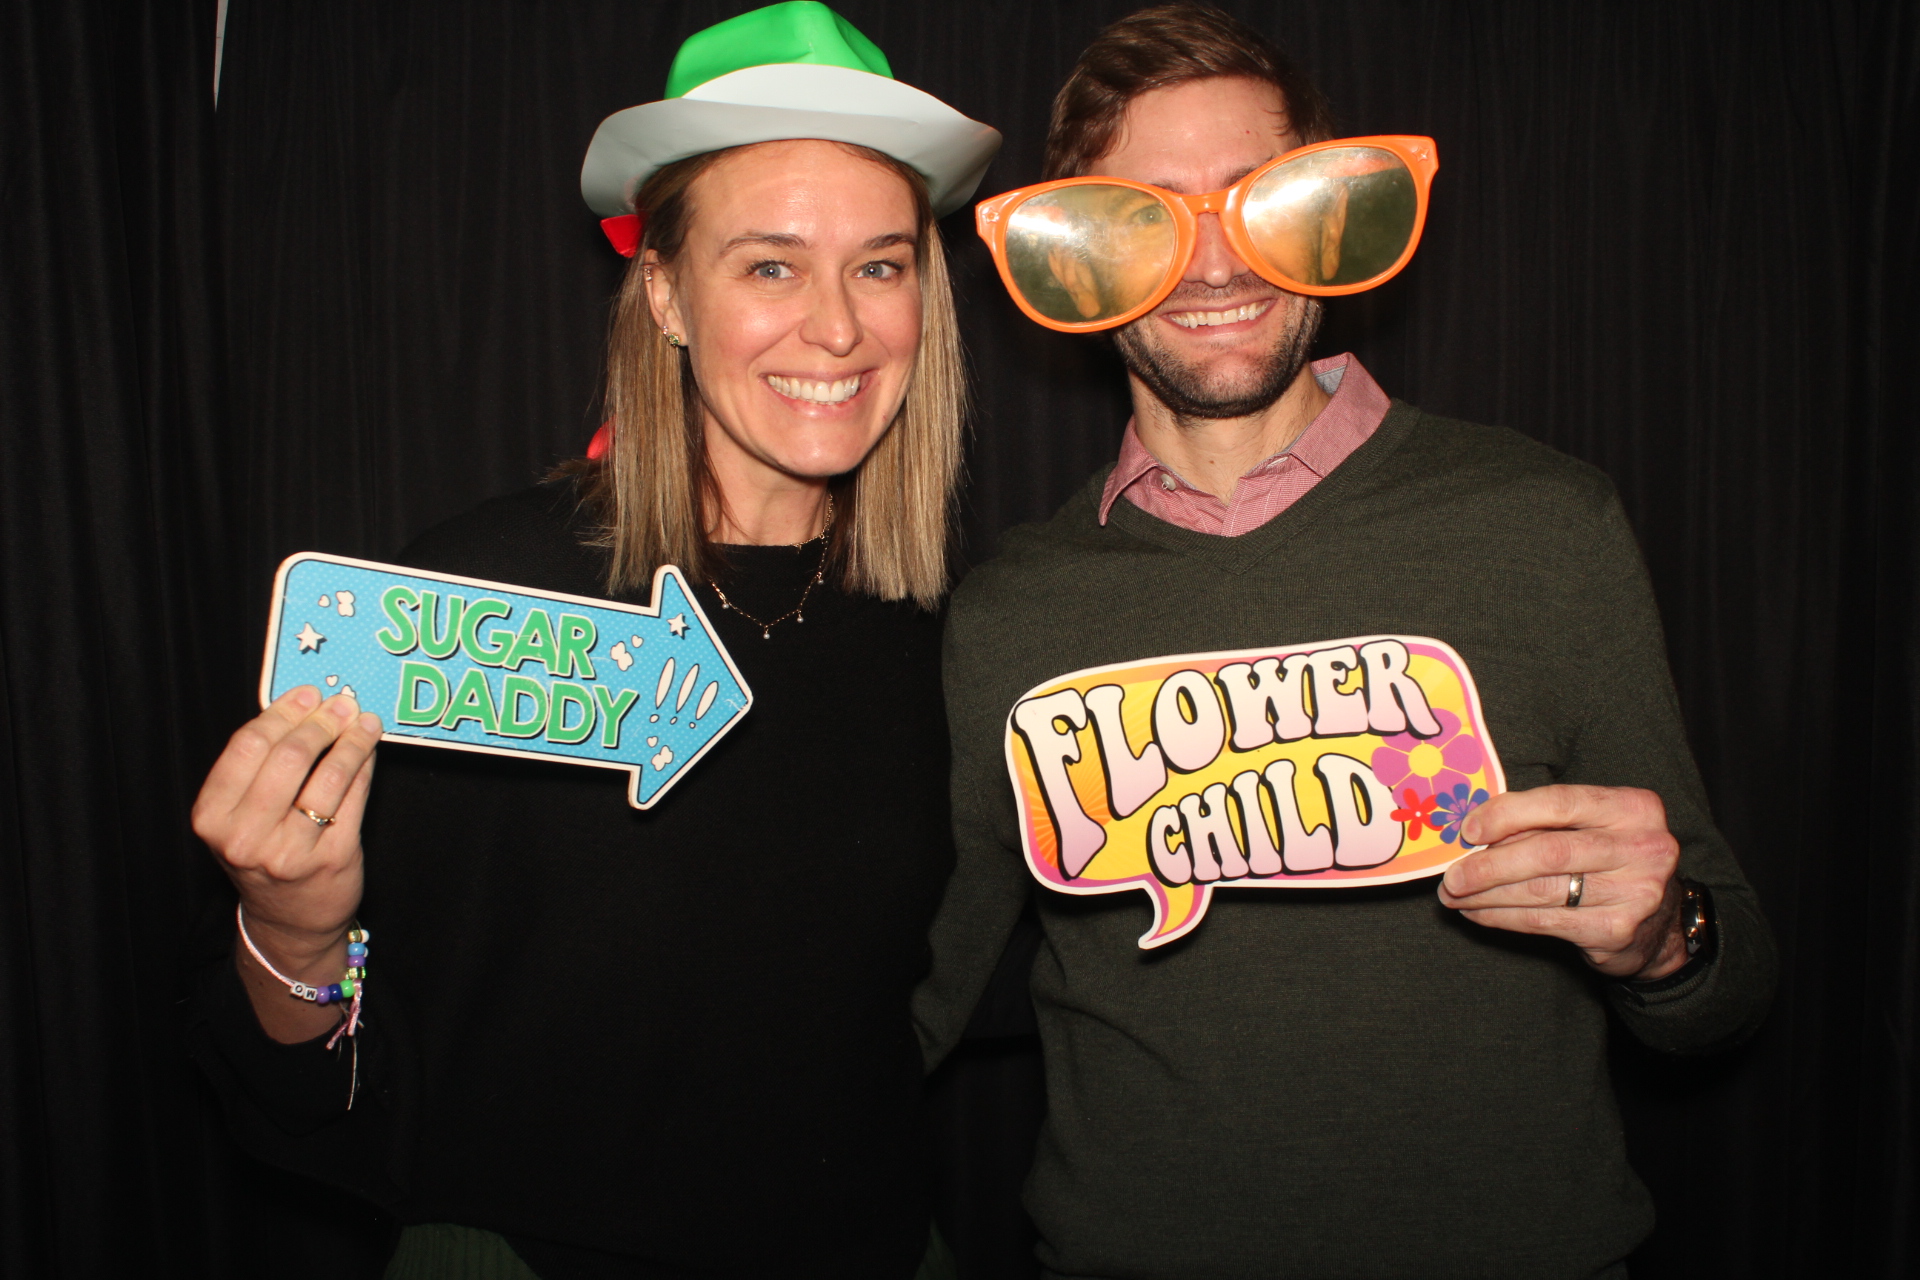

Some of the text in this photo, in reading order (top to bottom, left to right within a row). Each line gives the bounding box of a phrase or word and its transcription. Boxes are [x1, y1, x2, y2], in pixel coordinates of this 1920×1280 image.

[376, 586, 597, 679] SUGAR
[395, 661, 640, 748] DADDY
[1011, 639, 1442, 880] FLOWER
[1146, 753, 1405, 887] CHILD
